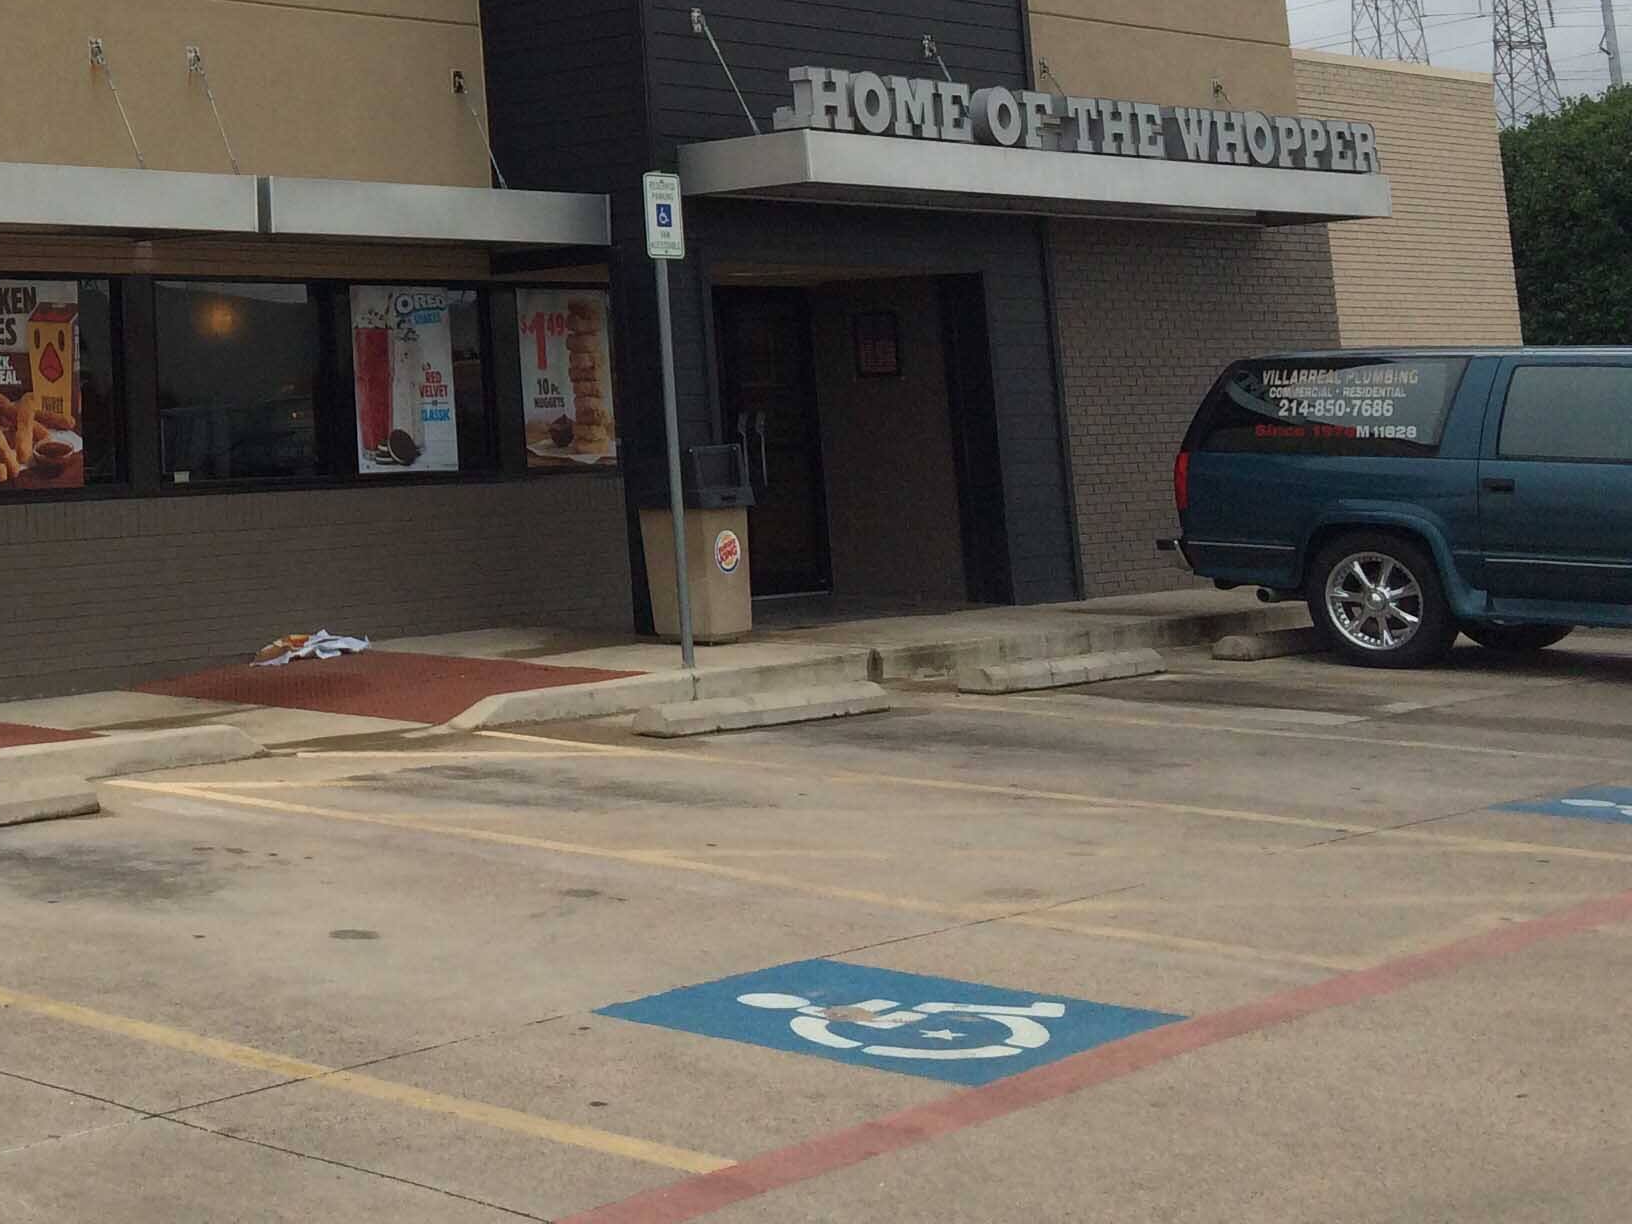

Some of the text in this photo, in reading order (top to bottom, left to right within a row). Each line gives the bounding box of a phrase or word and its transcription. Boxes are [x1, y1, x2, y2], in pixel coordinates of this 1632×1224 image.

[808, 69, 1381, 174] HOME OF THE WHOPPER
[1263, 369, 1418, 384] VILLARREAL PLUMBING
[536, 378, 550, 395] 10
[1269, 386, 1407, 398] COMMERCIAL RESIDENTIAL
